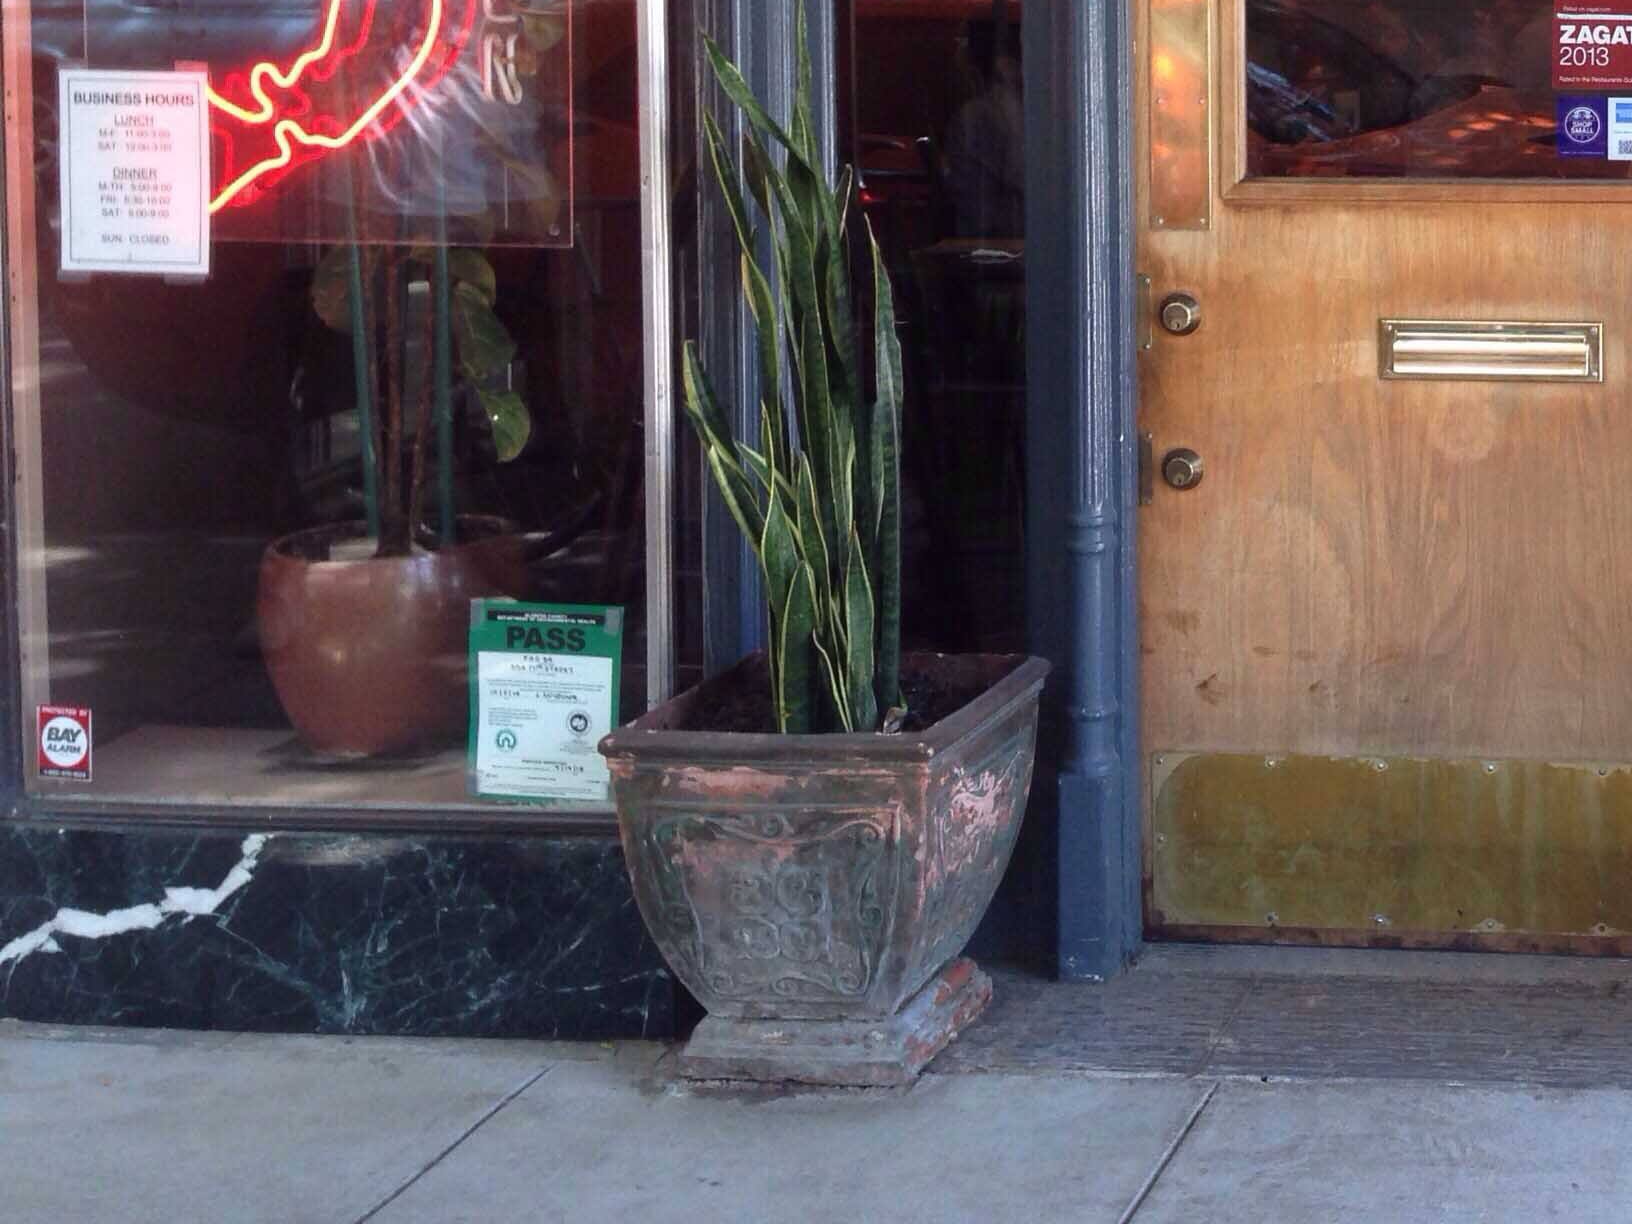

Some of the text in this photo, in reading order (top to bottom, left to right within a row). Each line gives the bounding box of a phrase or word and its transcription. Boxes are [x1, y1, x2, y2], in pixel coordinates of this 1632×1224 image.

[1559, 47, 1609, 66] 2013
[73, 91, 195, 107] BUSINESS HOURS
[113, 114, 155, 127] LUNCH
[112, 166, 158, 180] DINNER
[128, 234, 170, 244] CLOSED
[506, 625, 587, 653] PASS
[47, 727, 82, 743] BAY
[47, 744, 82, 754] ALARM
